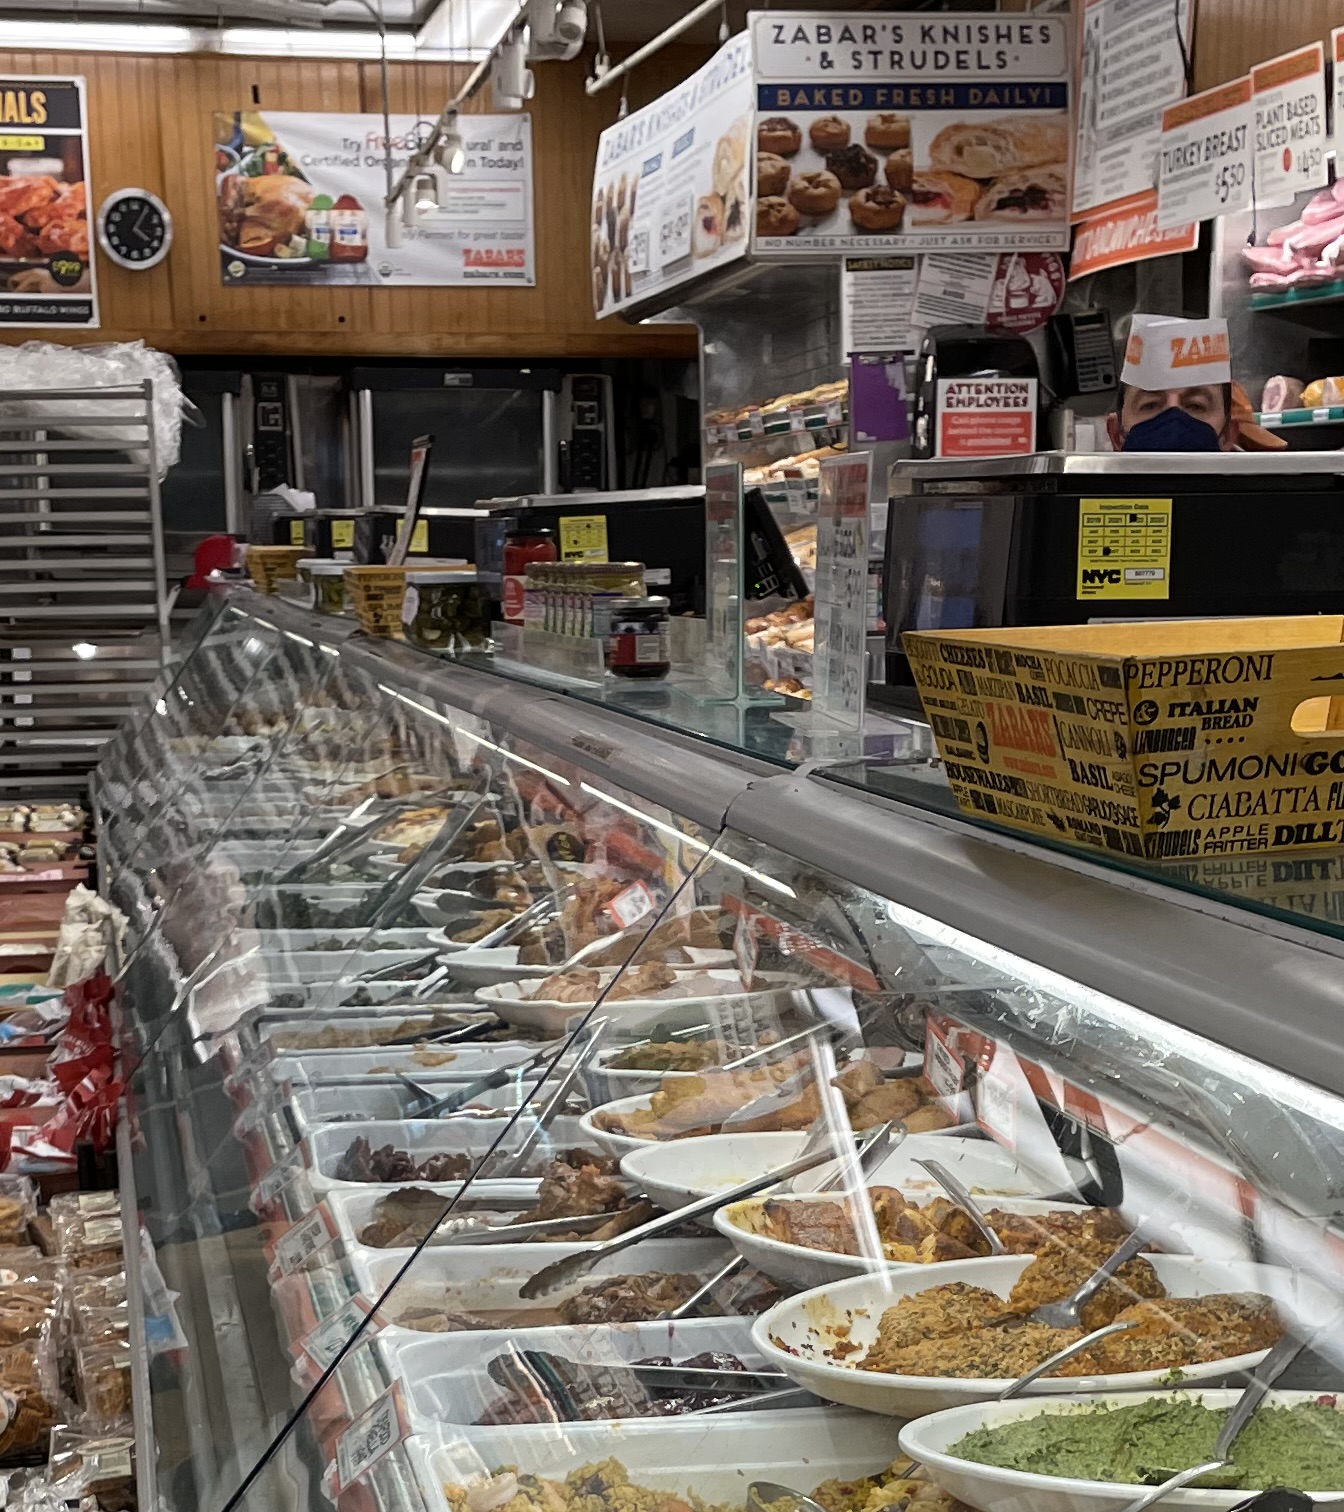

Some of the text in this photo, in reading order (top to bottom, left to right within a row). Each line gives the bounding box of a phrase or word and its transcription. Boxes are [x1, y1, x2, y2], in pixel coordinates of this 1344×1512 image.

[772, 24, 1051, 45] ZABAR'S KNISHES
[819, 50, 1008, 70] & STRUDELS
[776, 87, 1051, 106] BAKED FRESH DAILY!
[1256, 94, 1318, 129] PLANT BASED
[1257, 114, 1321, 151] SLICED MEATS
[342, 138, 524, 152] Try and
[1162, 138, 1204, 173] TURKEY
[1204, 124, 1248, 161] BREAST
[301, 155, 360, 167] Certified
[479, 156, 525, 170] Today!
[764, 238, 782, 247] NO
[785, 237, 835, 247] NUMBER
[840, 236, 906, 247] NECESSARY
[918, 236, 946, 246] JUST
[951, 236, 974, 246] ASK
[977, 235, 1000, 246] FOR
[946, 383, 1029, 394] ATTENTION
[946, 396, 1029, 408] EMPLOYEES
[1082, 569, 1121, 584] NYC
[939, 643, 987, 669] CHEESES
[1043, 657, 1101, 691] FOCACCIA
[1123, 654, 1275, 690] PEPPERONI
[922, 664, 958, 692] GOUDA
[1015, 682, 1053, 709] BASIL
[1086, 697, 1129, 726] CREPE
[1167, 697, 1260, 718] ITALIAN
[1201, 713, 1254, 731] BREAD
[1059, 720, 1113, 757] CANNOLI
[1068, 758, 1113, 791] BASIL
[1138, 752, 1298, 787] SPUMONI
[1187, 785, 1321, 821] CIABATTA
[1204, 823, 1270, 840] APPLE
[1272, 821, 1338, 847] DILL
[1204, 838, 1269, 854] FRITTER
